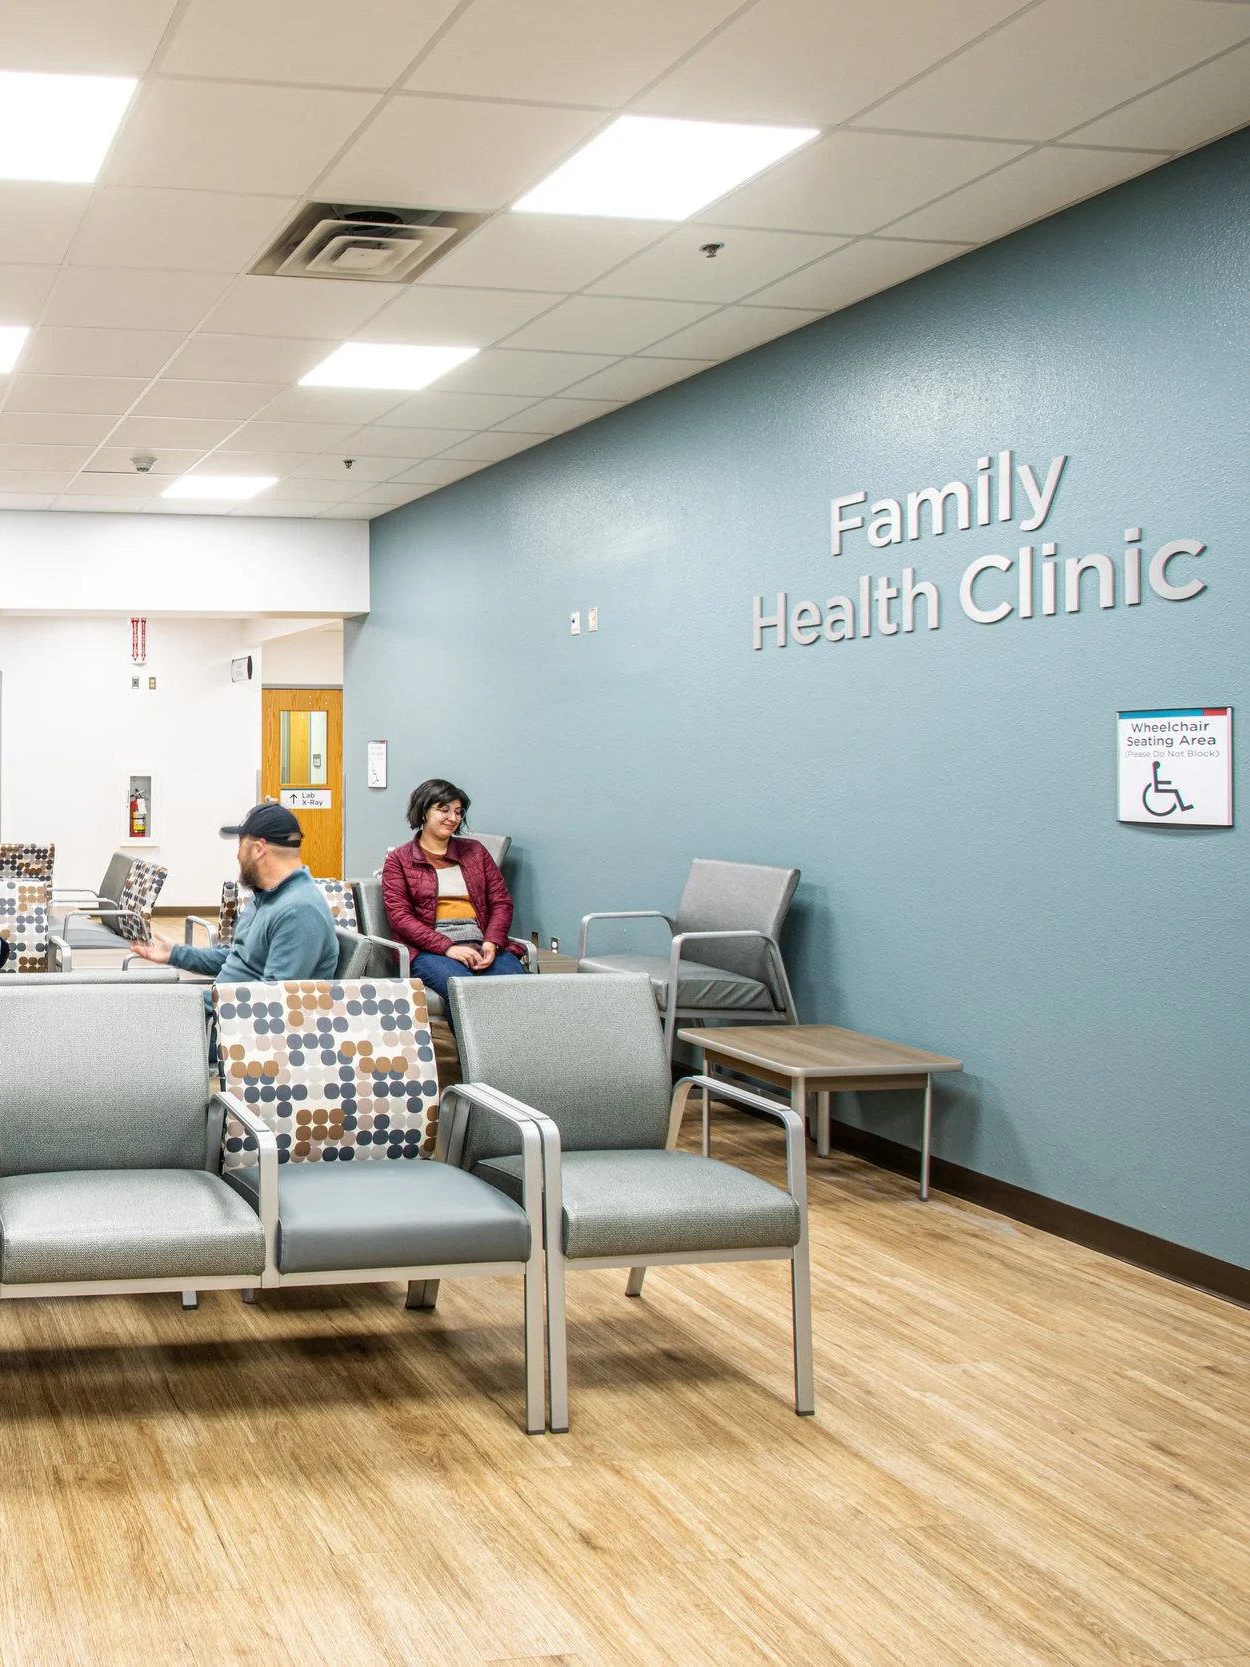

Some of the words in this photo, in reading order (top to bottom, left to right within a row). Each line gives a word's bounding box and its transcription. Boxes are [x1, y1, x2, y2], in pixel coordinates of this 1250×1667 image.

[830, 450, 1068, 556] Family
[752, 567, 940, 650] Health
[959, 527, 1207, 625] Clinic
[1131, 721, 1210, 733] Wheelchair
[1127, 736, 1174, 748] Seating
[1179, 735, 1216, 746] Area
[1125, 750, 1151, 758] (Please
[1153, 750, 1165, 758] Do
[1167, 750, 1184, 758] Not
[1187, 750, 1220, 758] Block)
